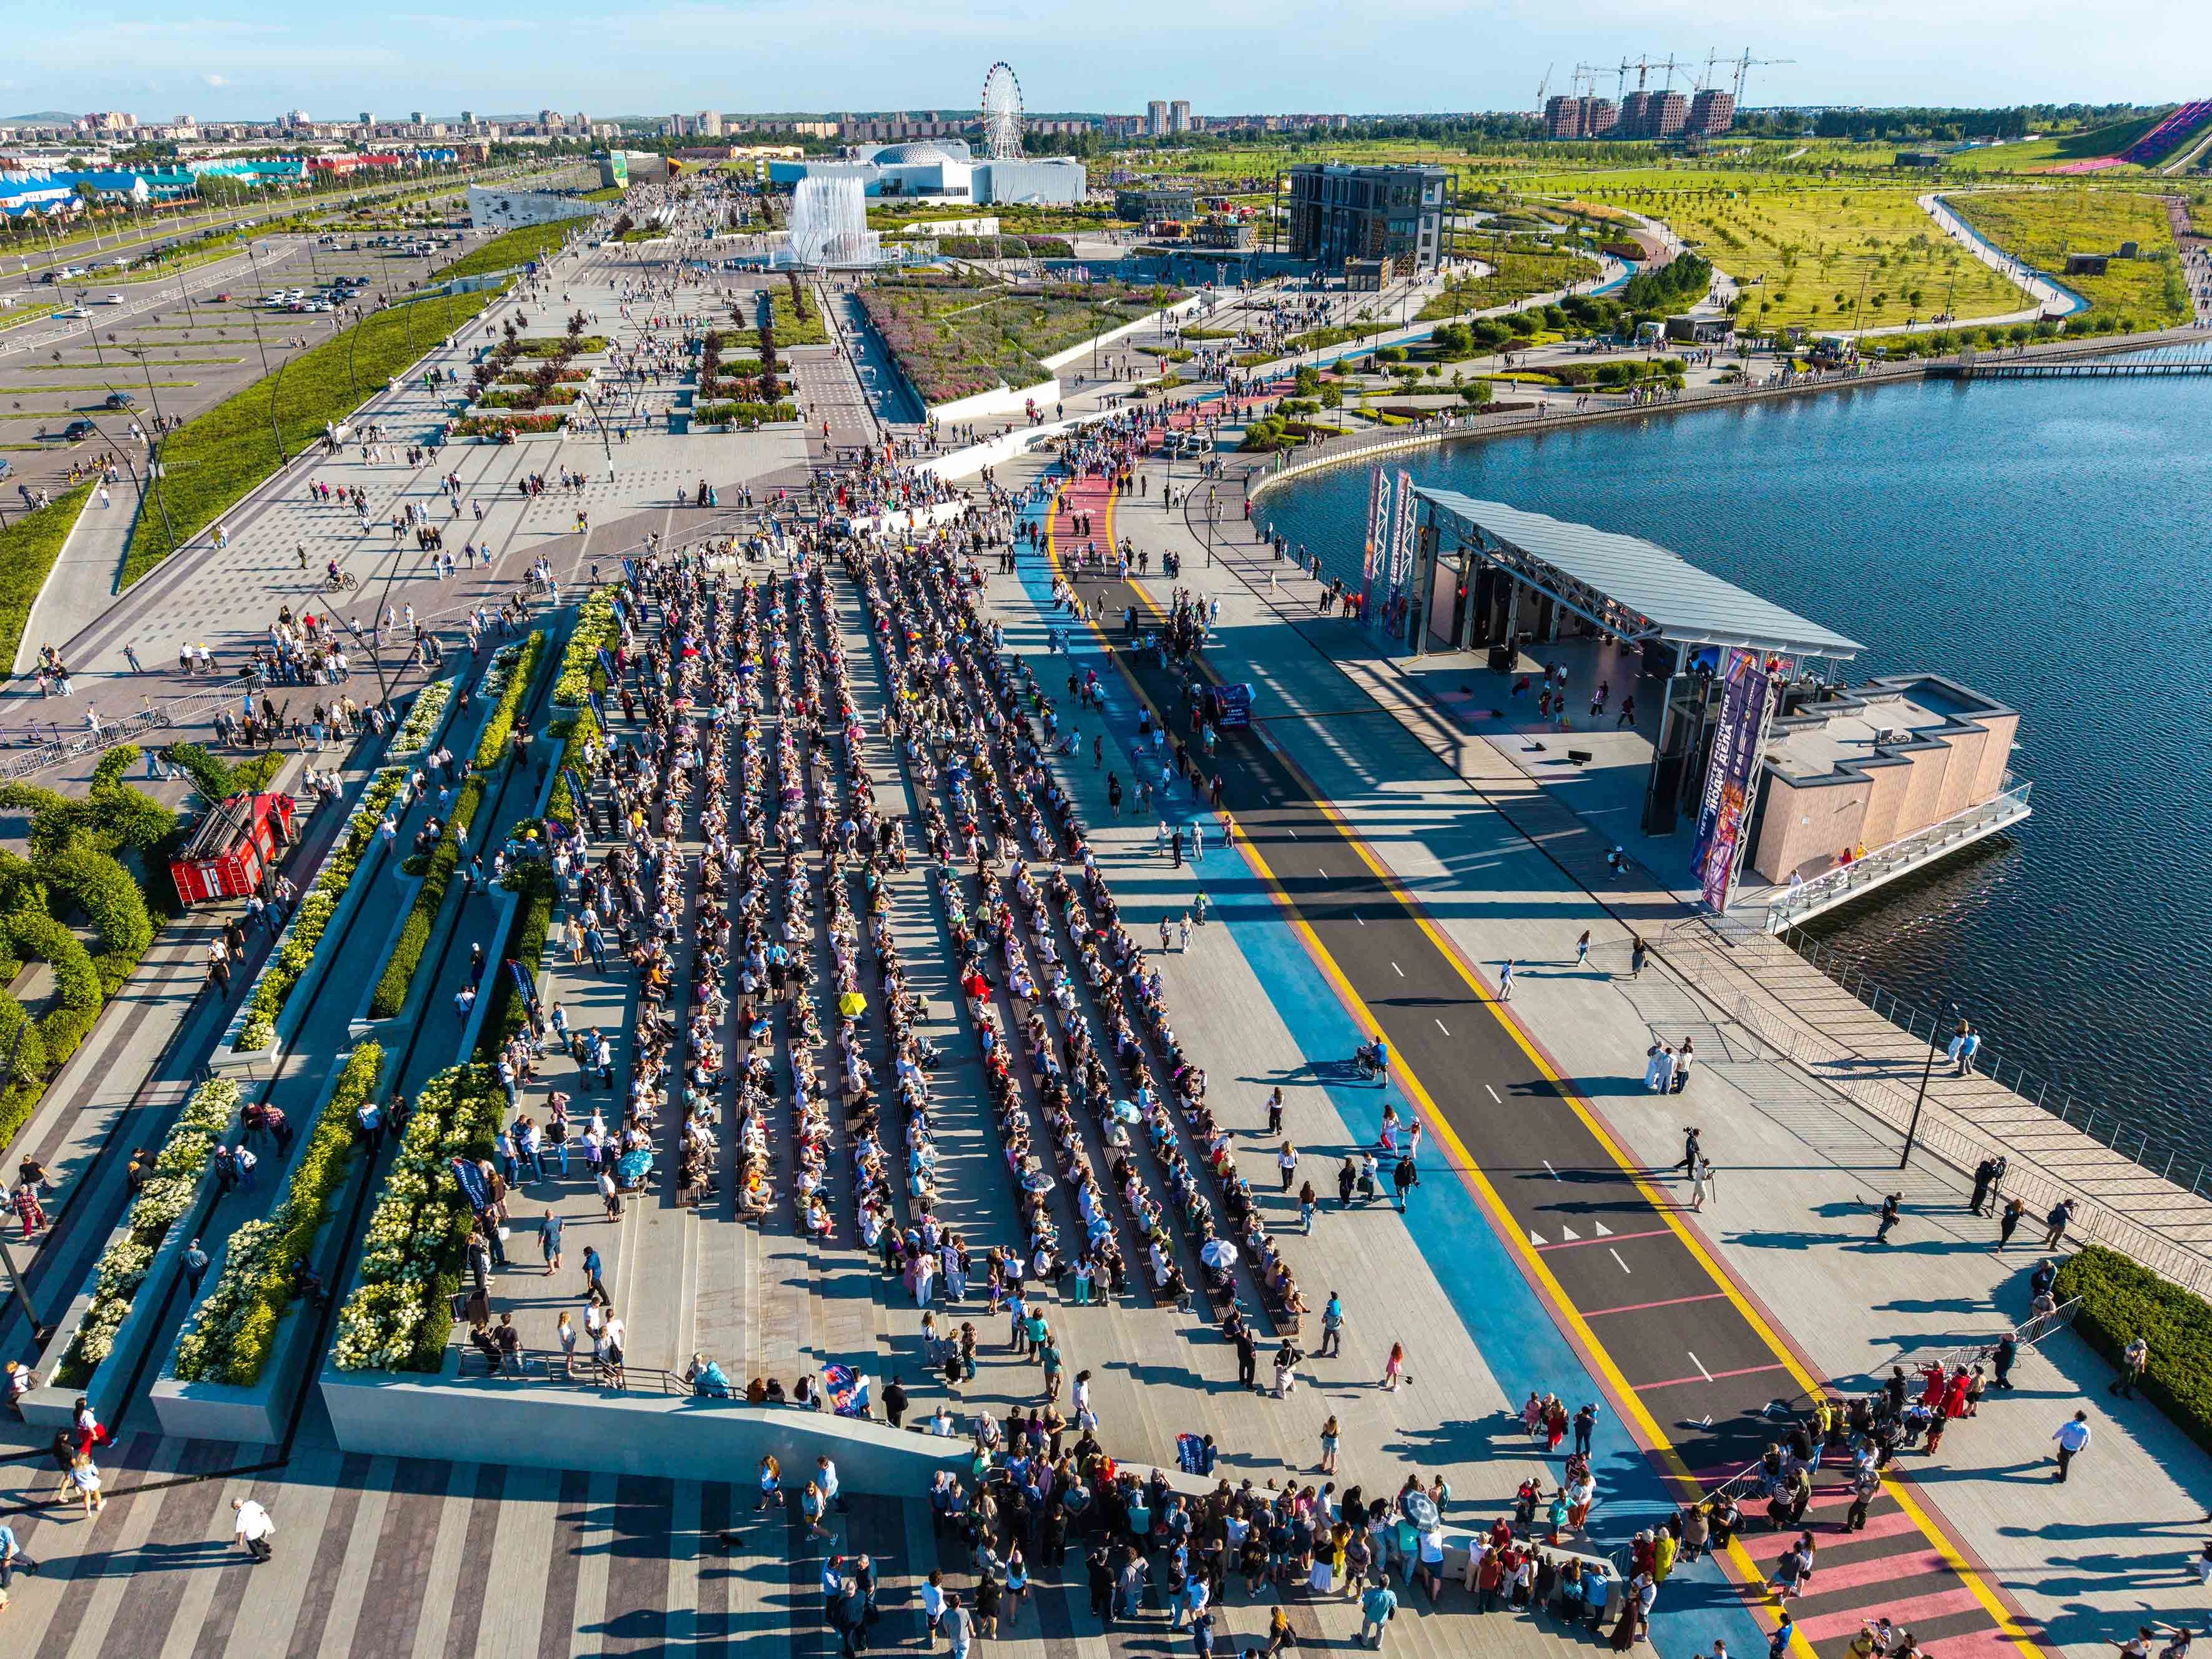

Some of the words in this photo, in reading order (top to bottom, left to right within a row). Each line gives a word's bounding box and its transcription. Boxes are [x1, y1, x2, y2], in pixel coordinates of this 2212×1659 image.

[1699, 761, 1718, 837] МЕТАЛЛУРГИ
[1714, 694, 1730, 761] МАГНИТКИ
[1709, 767, 1724, 815] ЛЮДИ
[1719, 725, 1733, 766] ДЕЛА
